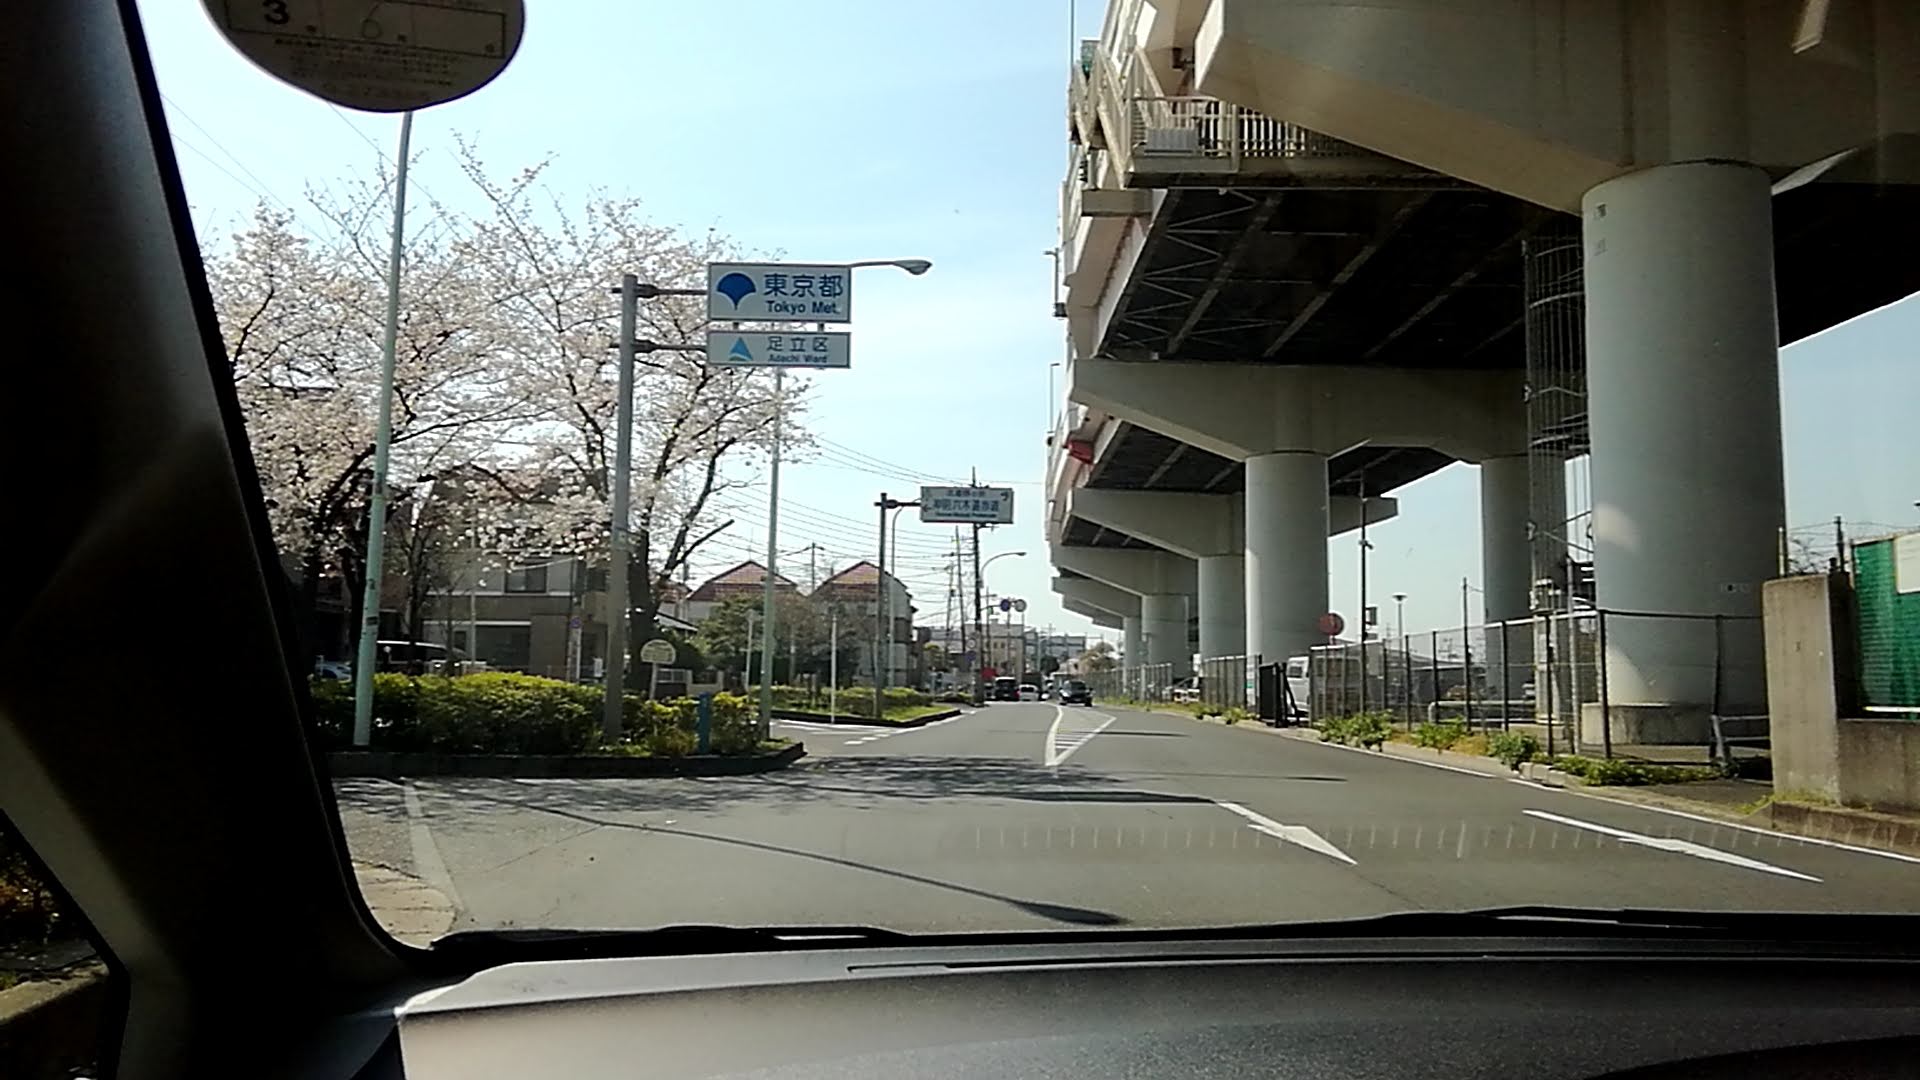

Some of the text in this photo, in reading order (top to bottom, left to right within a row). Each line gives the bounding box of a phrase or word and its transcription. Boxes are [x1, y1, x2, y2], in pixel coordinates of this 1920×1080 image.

[262, 0, 289, 25] 3
[763, 273, 843, 298] 東京都
[765, 300, 806, 315] Tokyo
[766, 335, 829, 352] 足立区
[803, 355, 828, 363] Ward
